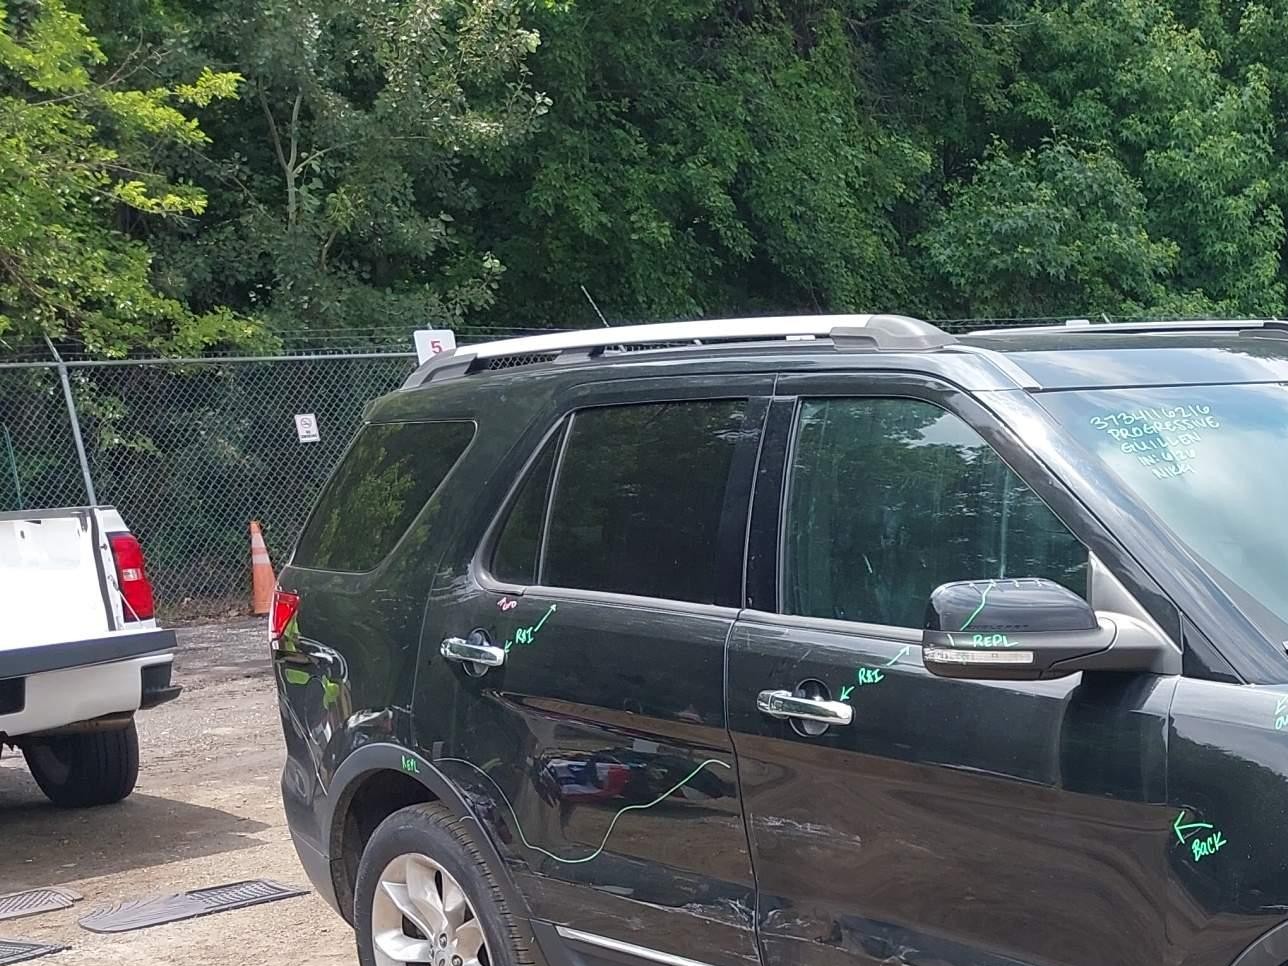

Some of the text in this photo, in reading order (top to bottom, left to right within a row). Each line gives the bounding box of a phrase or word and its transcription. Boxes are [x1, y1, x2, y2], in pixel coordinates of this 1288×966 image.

[430, 341, 443, 354] 5
[1107, 416, 1220, 440] PROGRESSIVE
[1121, 431, 1201, 453] GUILLEN
[972, 634, 1019, 648] REPL
